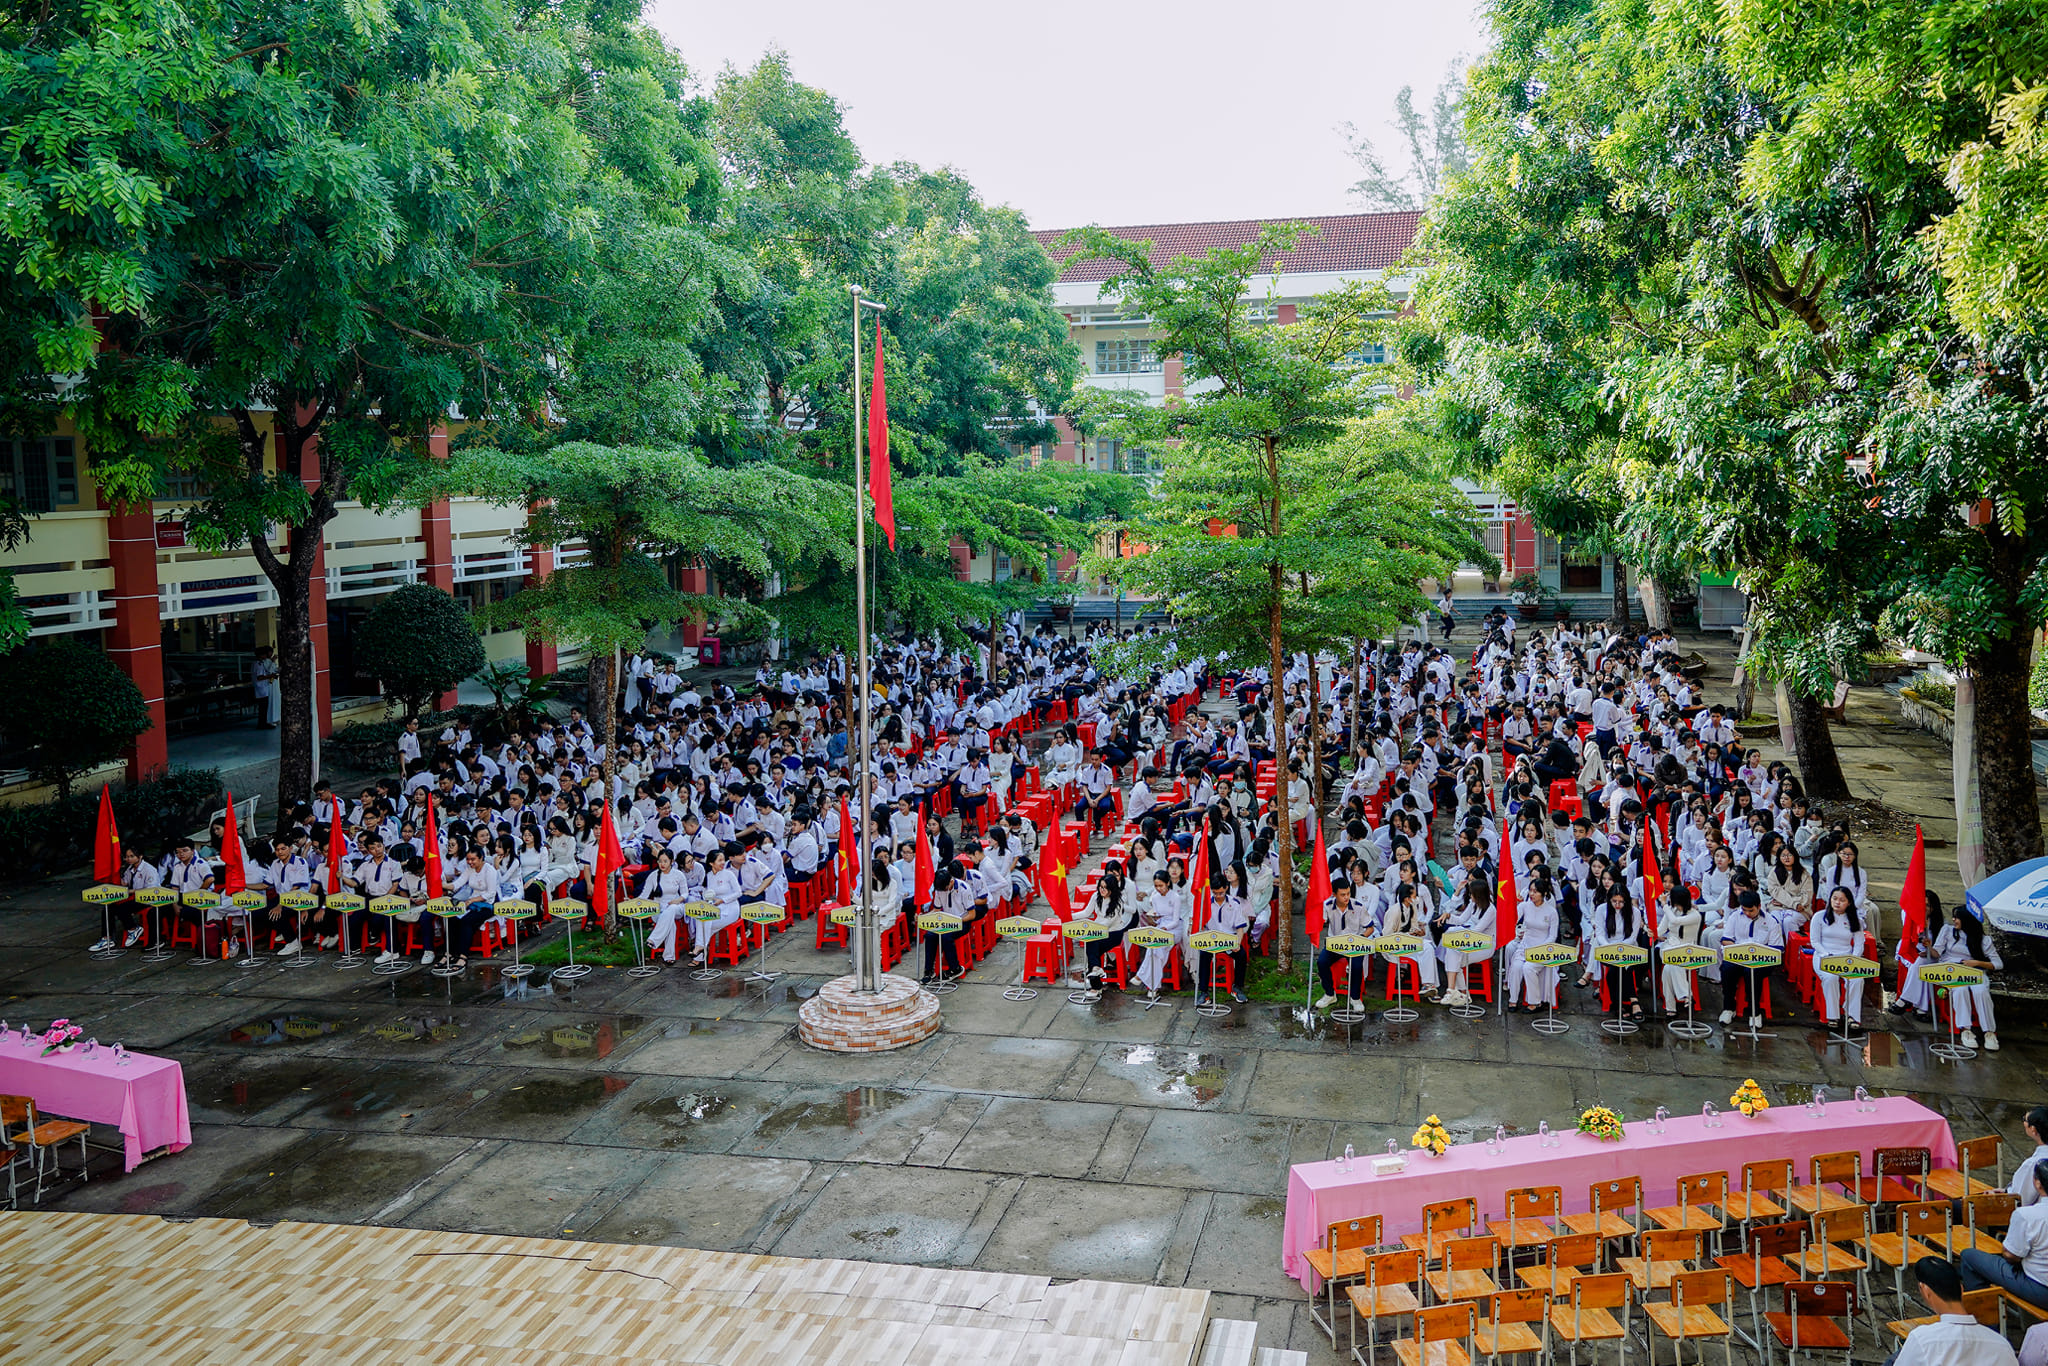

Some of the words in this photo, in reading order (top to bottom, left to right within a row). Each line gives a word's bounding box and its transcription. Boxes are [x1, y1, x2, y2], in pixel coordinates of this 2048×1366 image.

[1622, 954, 1642, 962] SINH
[1728, 952, 1750, 961] 10A8
[1752, 954, 1777, 963] KHXH
[1823, 964, 1850, 973] 10A9
[1852, 967, 1876, 976] ANH
[1924, 973, 1952, 982] 10A10
